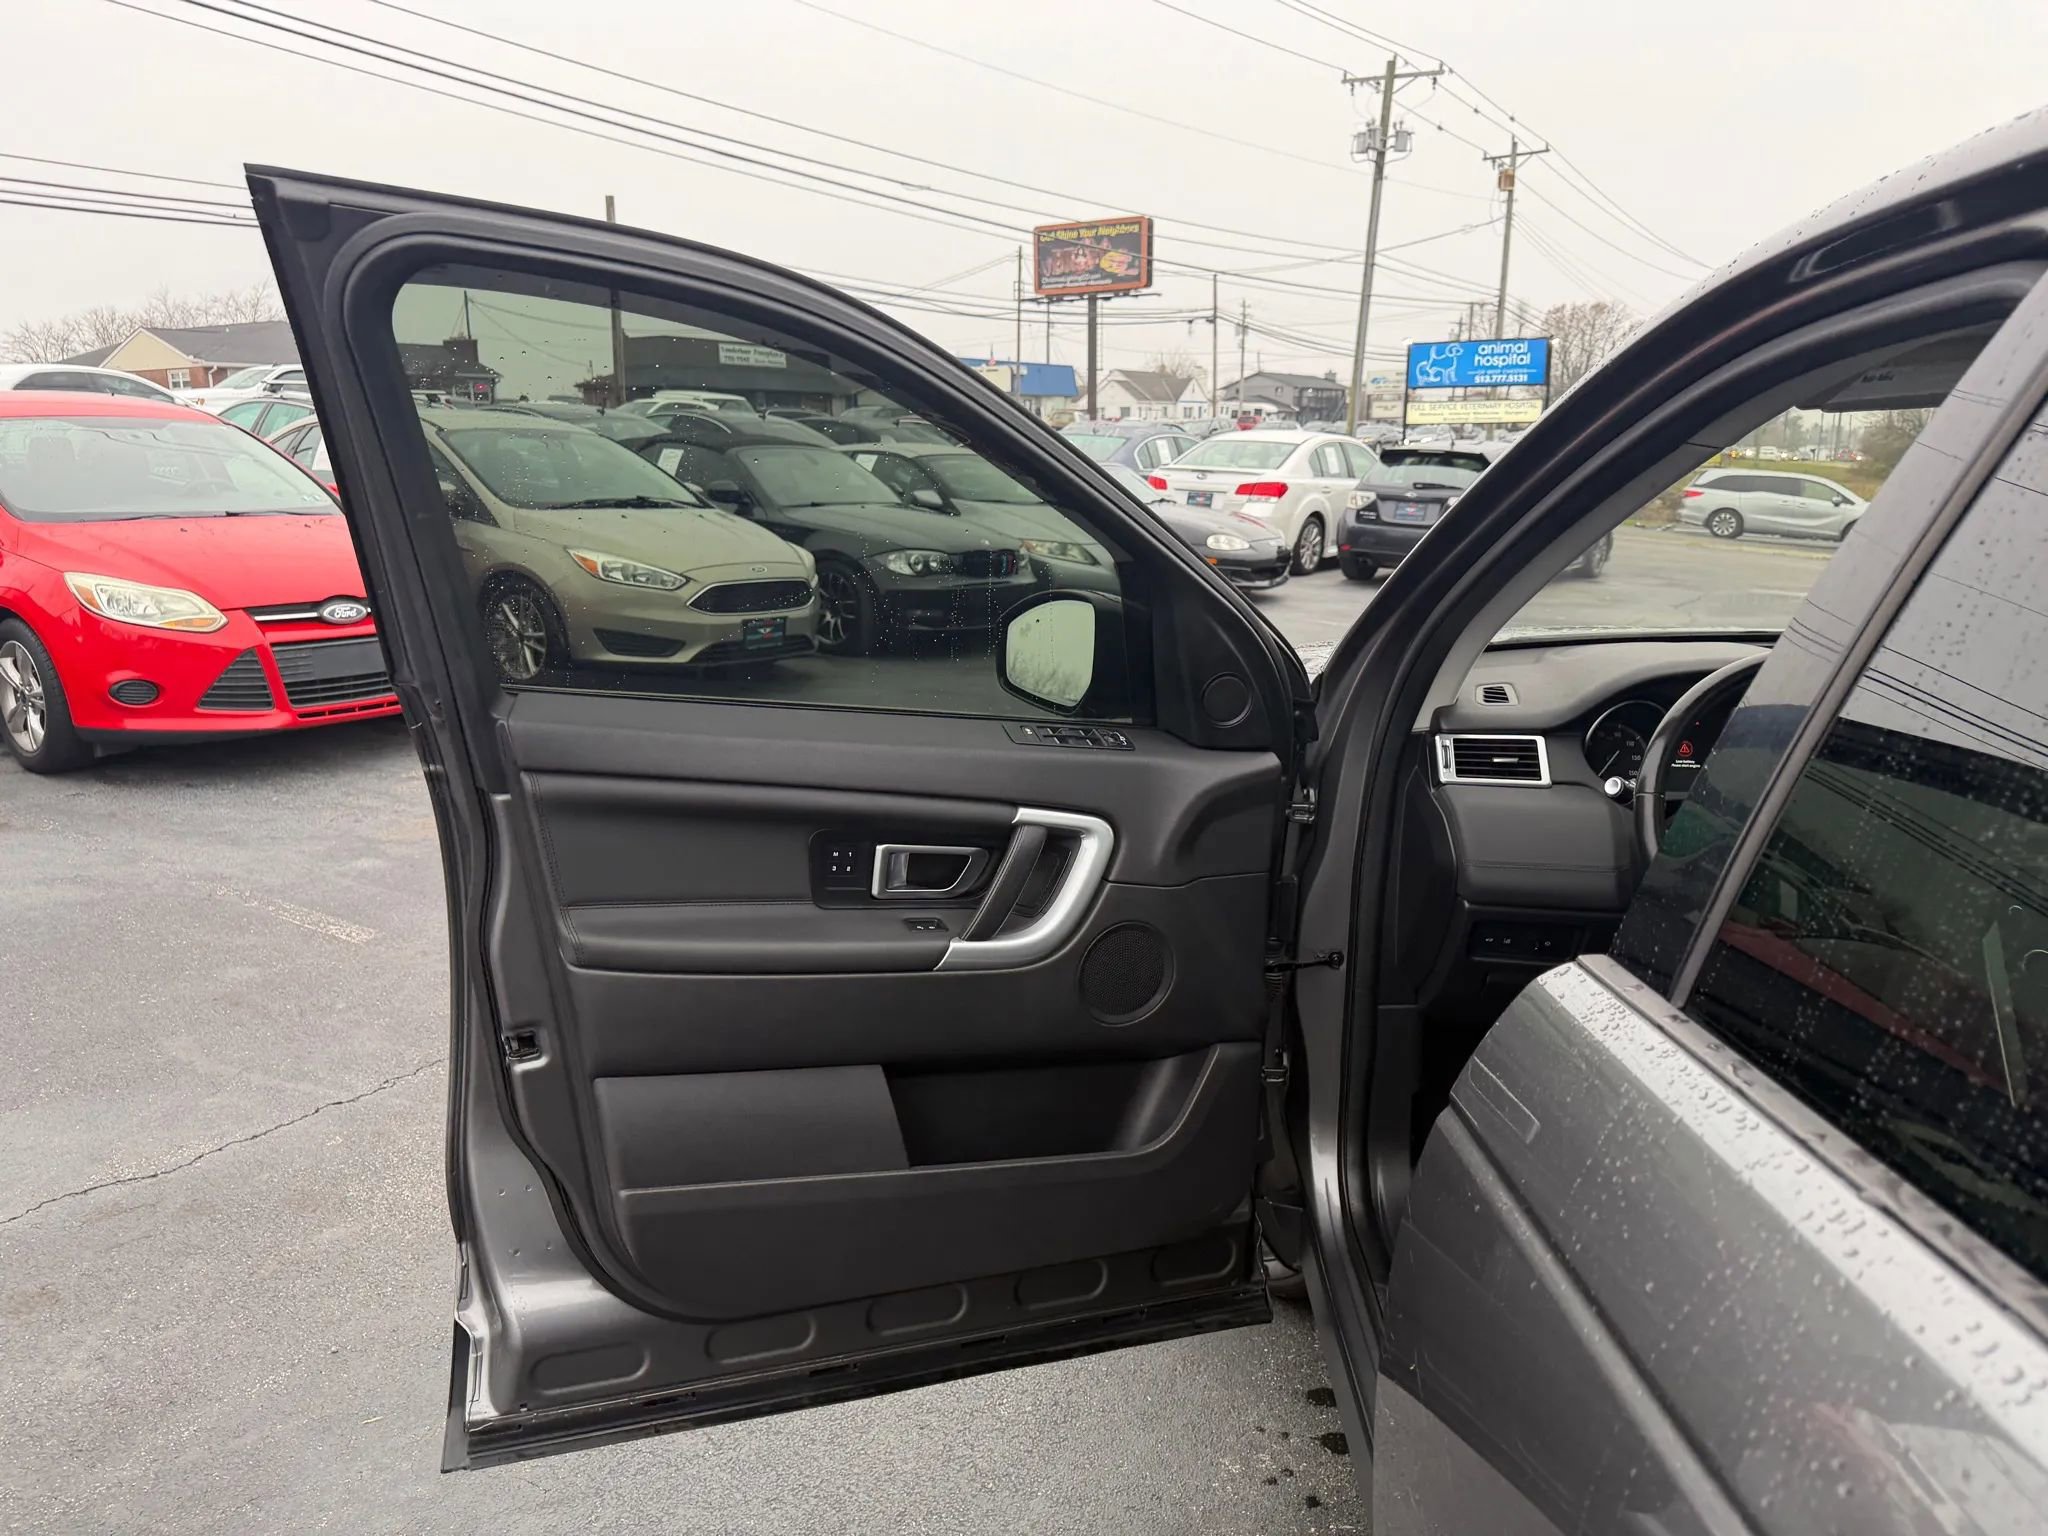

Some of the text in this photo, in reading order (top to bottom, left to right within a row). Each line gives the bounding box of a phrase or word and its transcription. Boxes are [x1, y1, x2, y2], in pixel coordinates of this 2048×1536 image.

[1079, 228, 1097, 238] Your
[1478, 341, 1528, 355] animal
[1474, 352, 1531, 367] hospital
[1429, 403, 1457, 411] SERVICE
[334, 606, 358, 619] Ford
